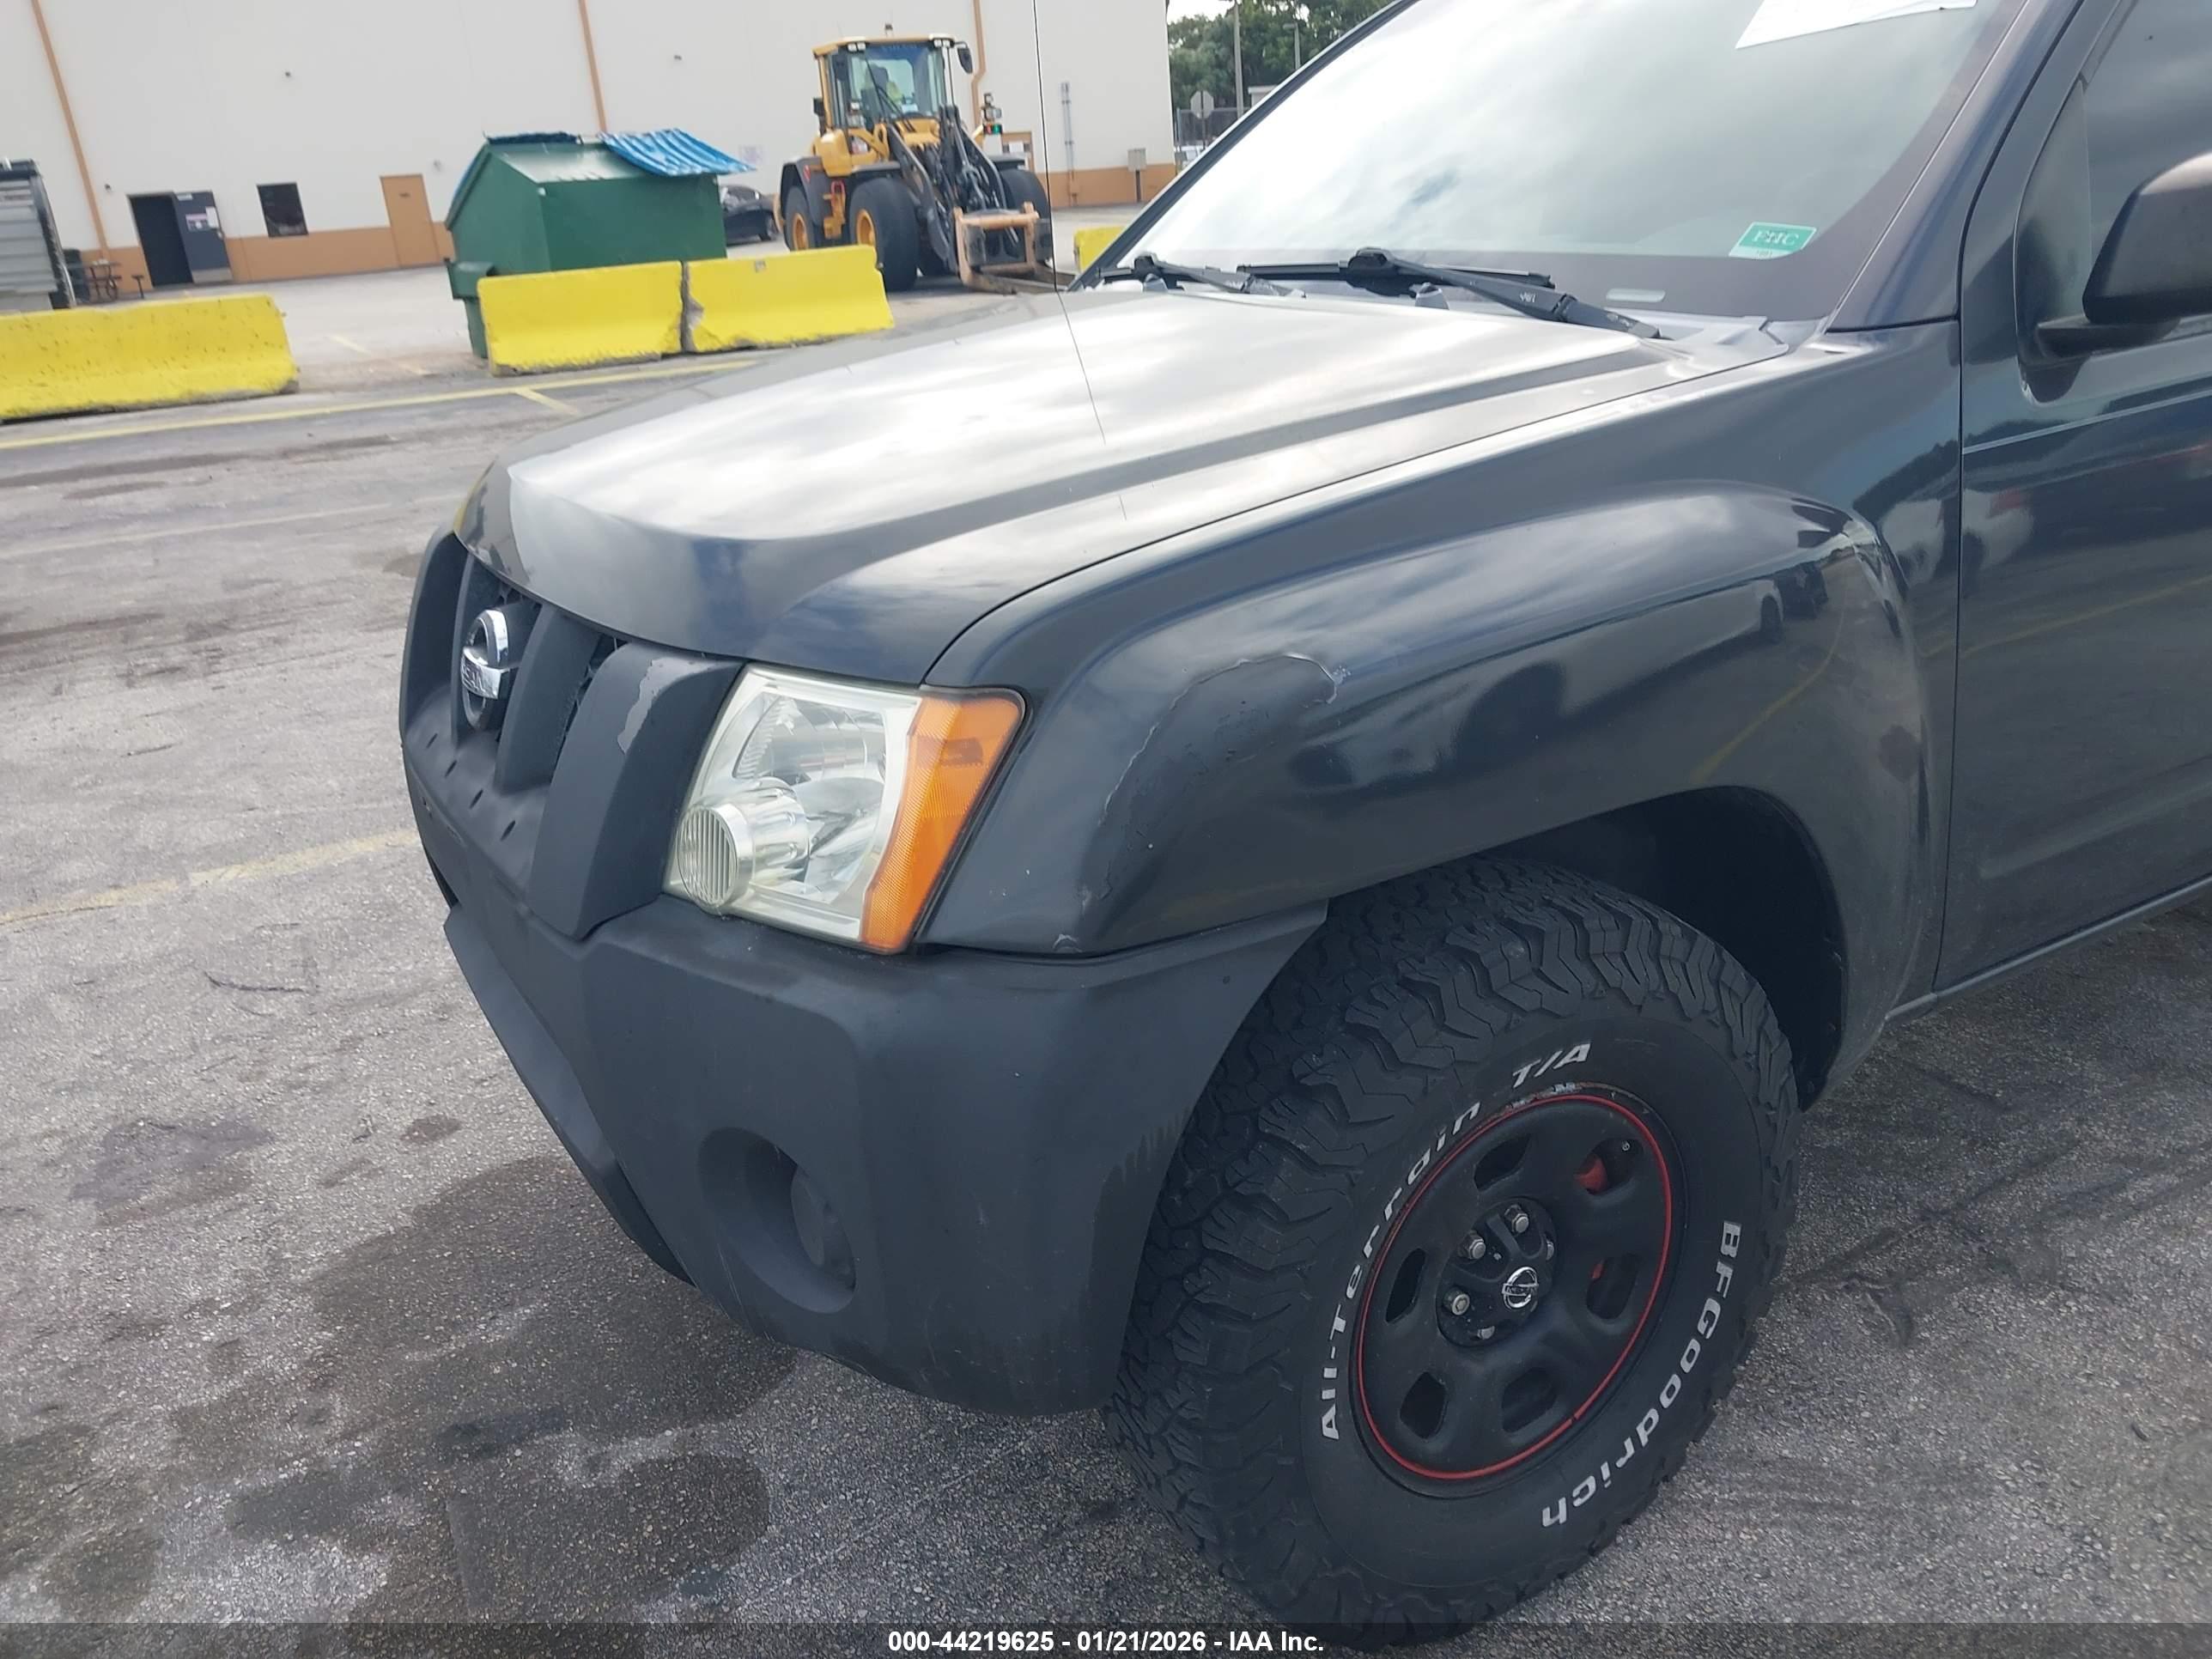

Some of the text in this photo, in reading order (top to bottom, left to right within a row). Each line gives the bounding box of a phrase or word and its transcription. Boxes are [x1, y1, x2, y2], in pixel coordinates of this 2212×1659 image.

[1321, 1042, 1592, 1442] All-Terrain T/A
[1540, 1220, 1742, 1529] BFGoodrich
